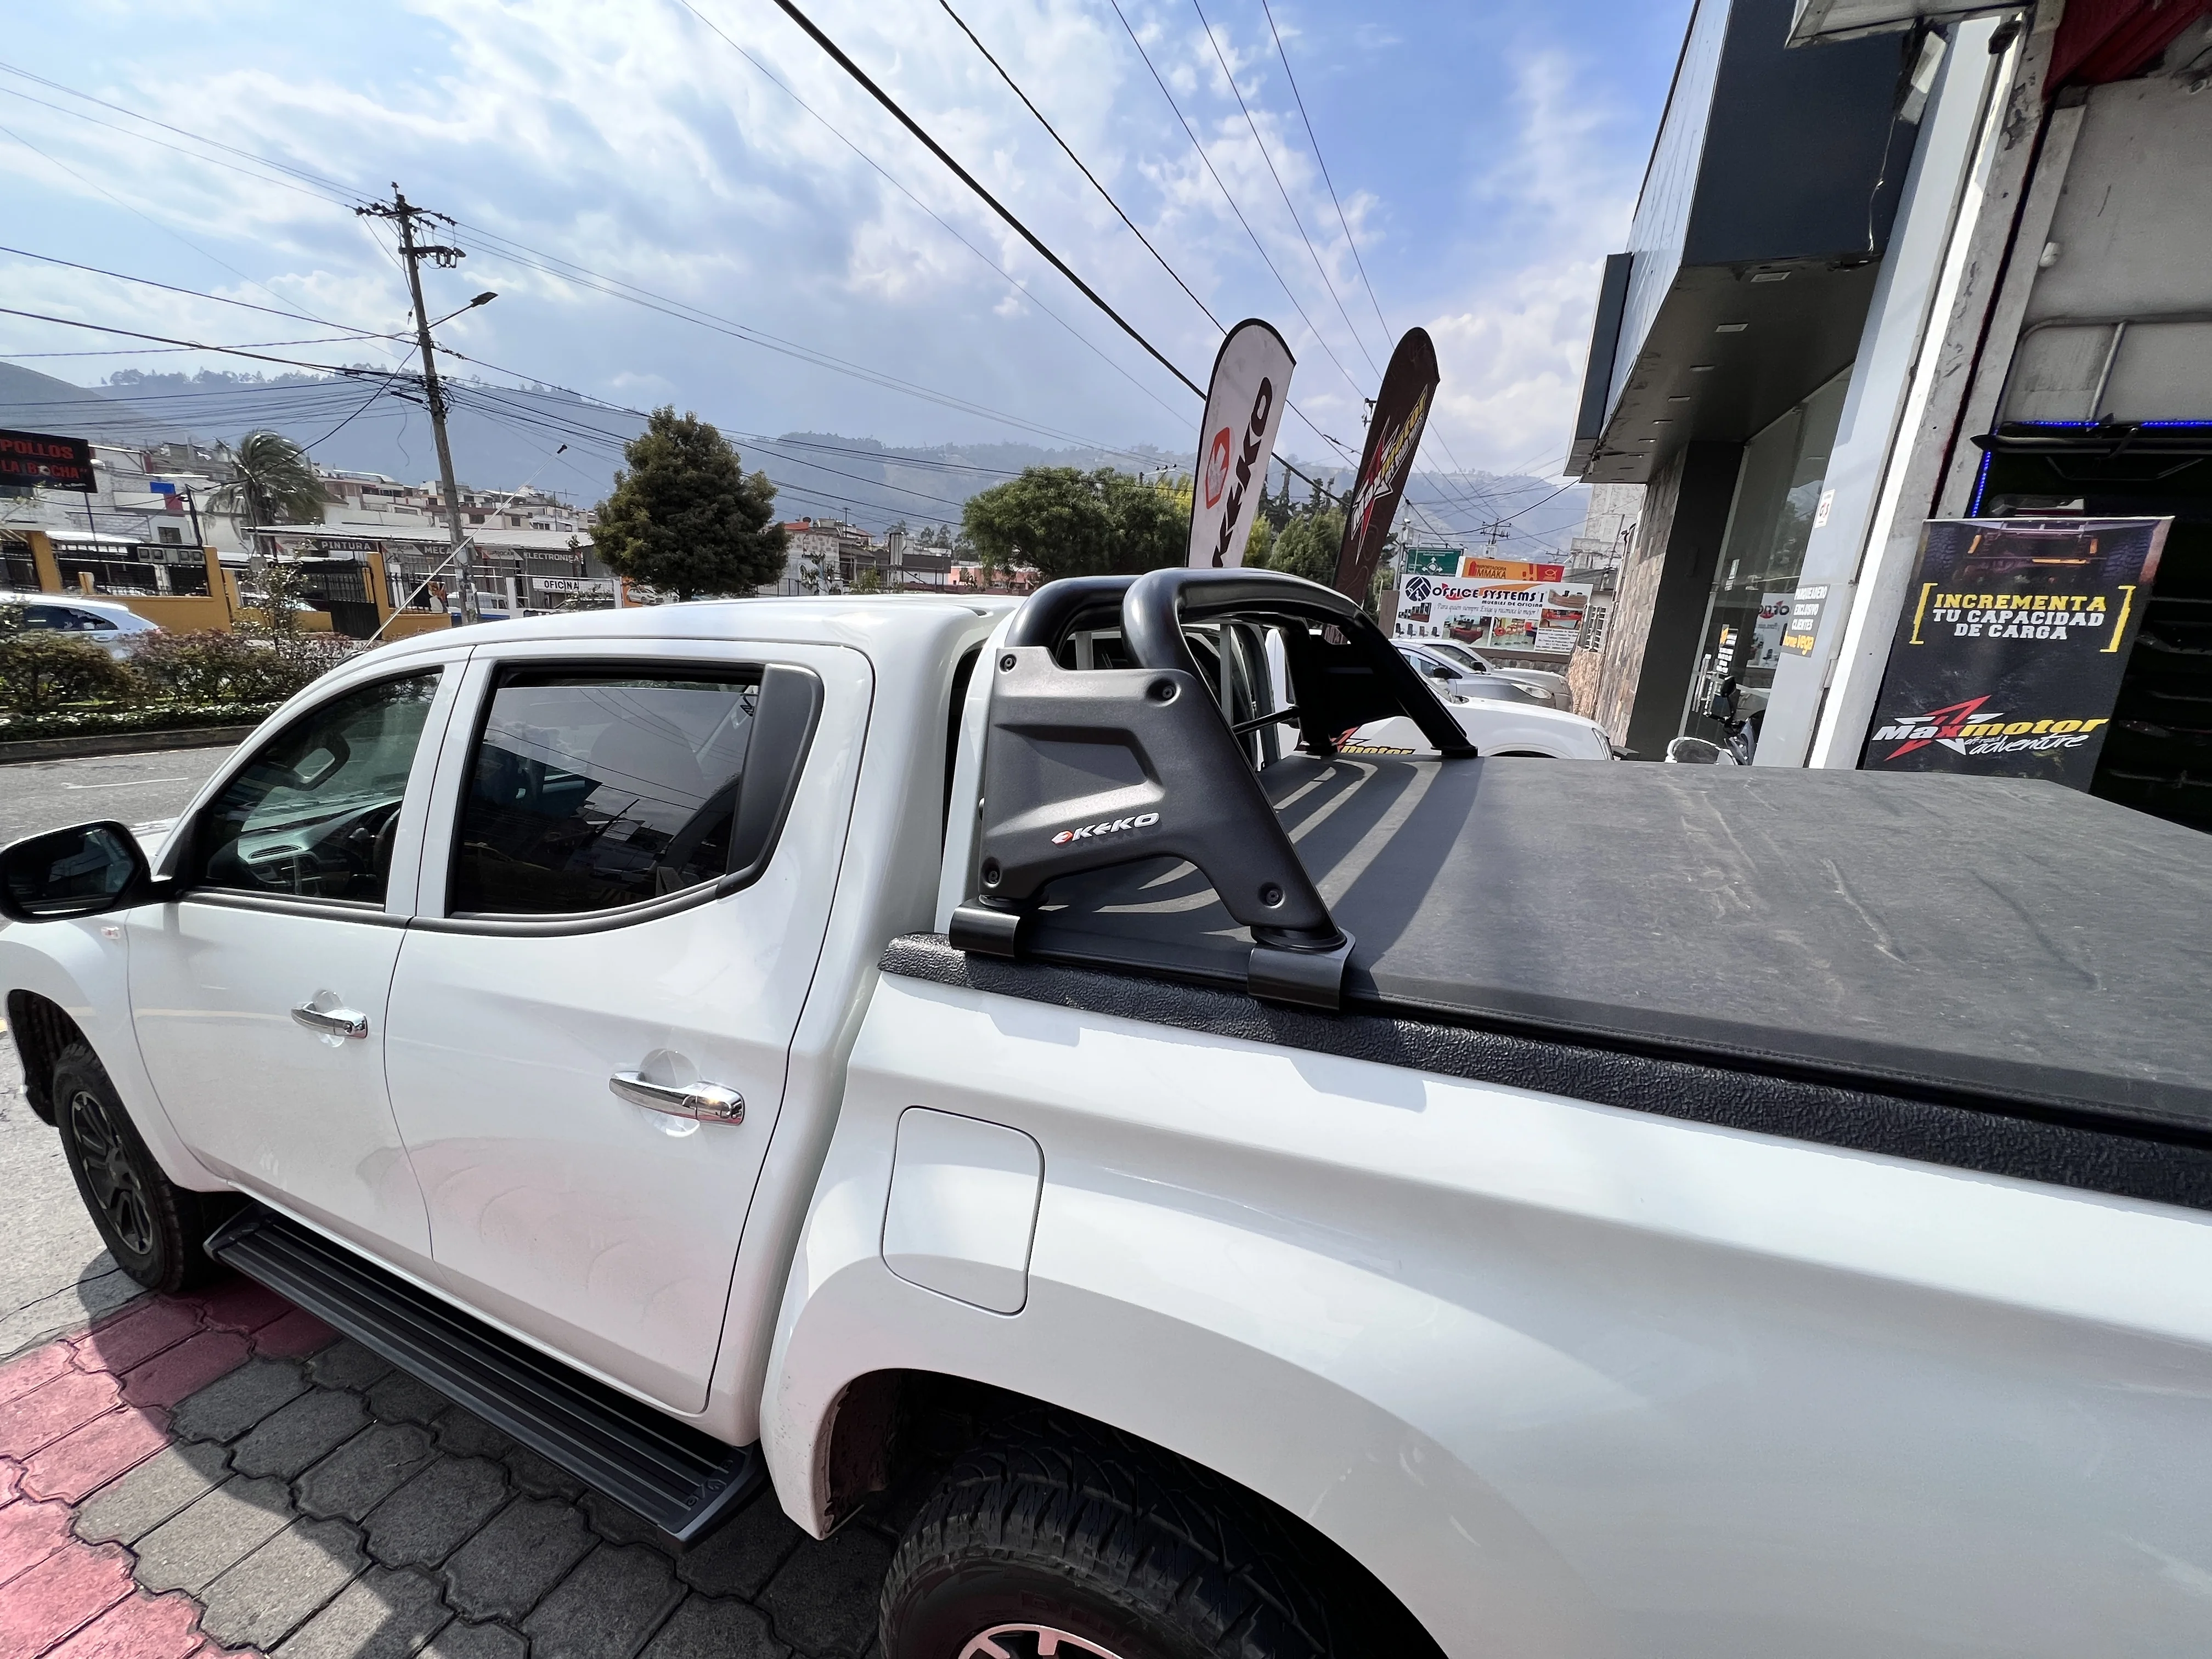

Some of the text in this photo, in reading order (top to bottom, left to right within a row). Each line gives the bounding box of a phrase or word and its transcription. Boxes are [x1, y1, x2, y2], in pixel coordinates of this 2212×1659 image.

[0, 438, 75, 460] POLLOS
[1, 459, 21, 473] LA
[321, 540, 371, 550] PINTURA
[523, 551, 580, 563] ELECTRONICA
[544, 579, 579, 590] OFICINA
[1432, 586, 1479, 599] OFFICE
[1482, 589, 1537, 602] SYSTEMS
[1934, 594, 2107, 612] INCREMENTA
[1791, 618, 1814, 631] CLIENTES
[1932, 610, 2105, 627] TU CAPACIDAD
[1954, 623, 2068, 640] DE CARGA
[1968, 732, 2089, 755] adventure
